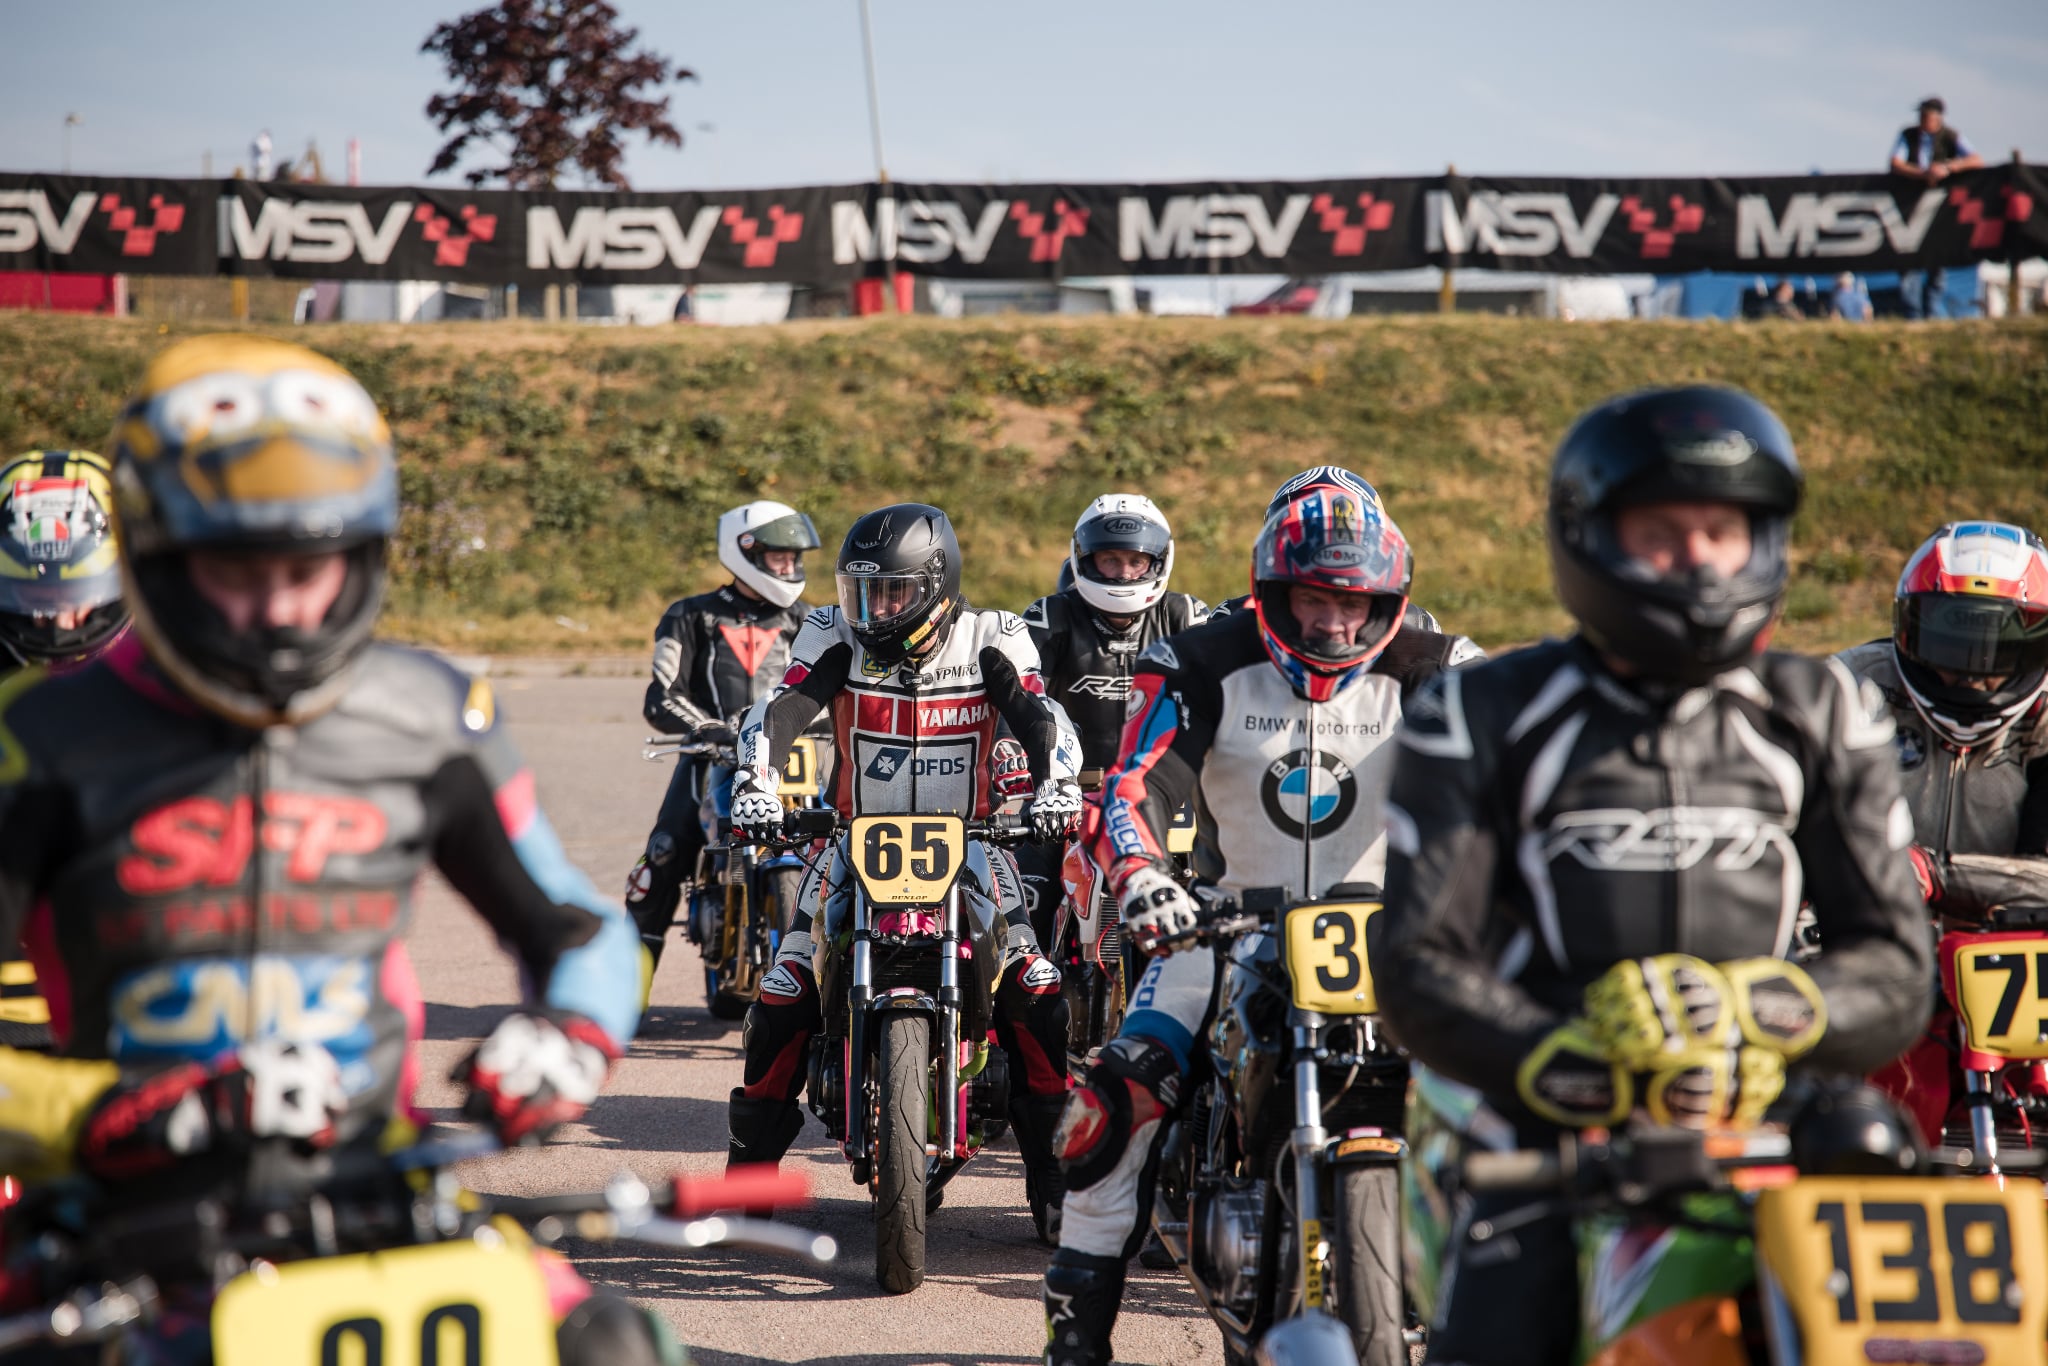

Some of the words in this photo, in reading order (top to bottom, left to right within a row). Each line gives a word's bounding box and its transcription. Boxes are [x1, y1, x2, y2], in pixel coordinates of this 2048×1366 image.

[218, 195, 412, 264] MSV
[527, 205, 722, 270] MSV
[832, 197, 1012, 264] MSV
[1119, 193, 1312, 262] MSV
[1424, 190, 1620, 258] MSV
[1736, 190, 1946, 258] MSV
[1110, 518, 1138, 530] Arai
[849, 564, 875, 572] HJC
[935, 661, 978, 681] YPMRC
[1068, 675, 1134, 696] RS
[919, 702, 990, 728] YAMAHA
[1245, 716, 1290, 732] BMW
[1298, 719, 1381, 735] Motorrad
[910, 757, 965, 776] DFDS
[1270, 750, 1352, 783] BMW
[864, 822, 950, 881] 65
[1974, 953, 2048, 1037] 7
[1816, 1202, 2022, 1322] 138
